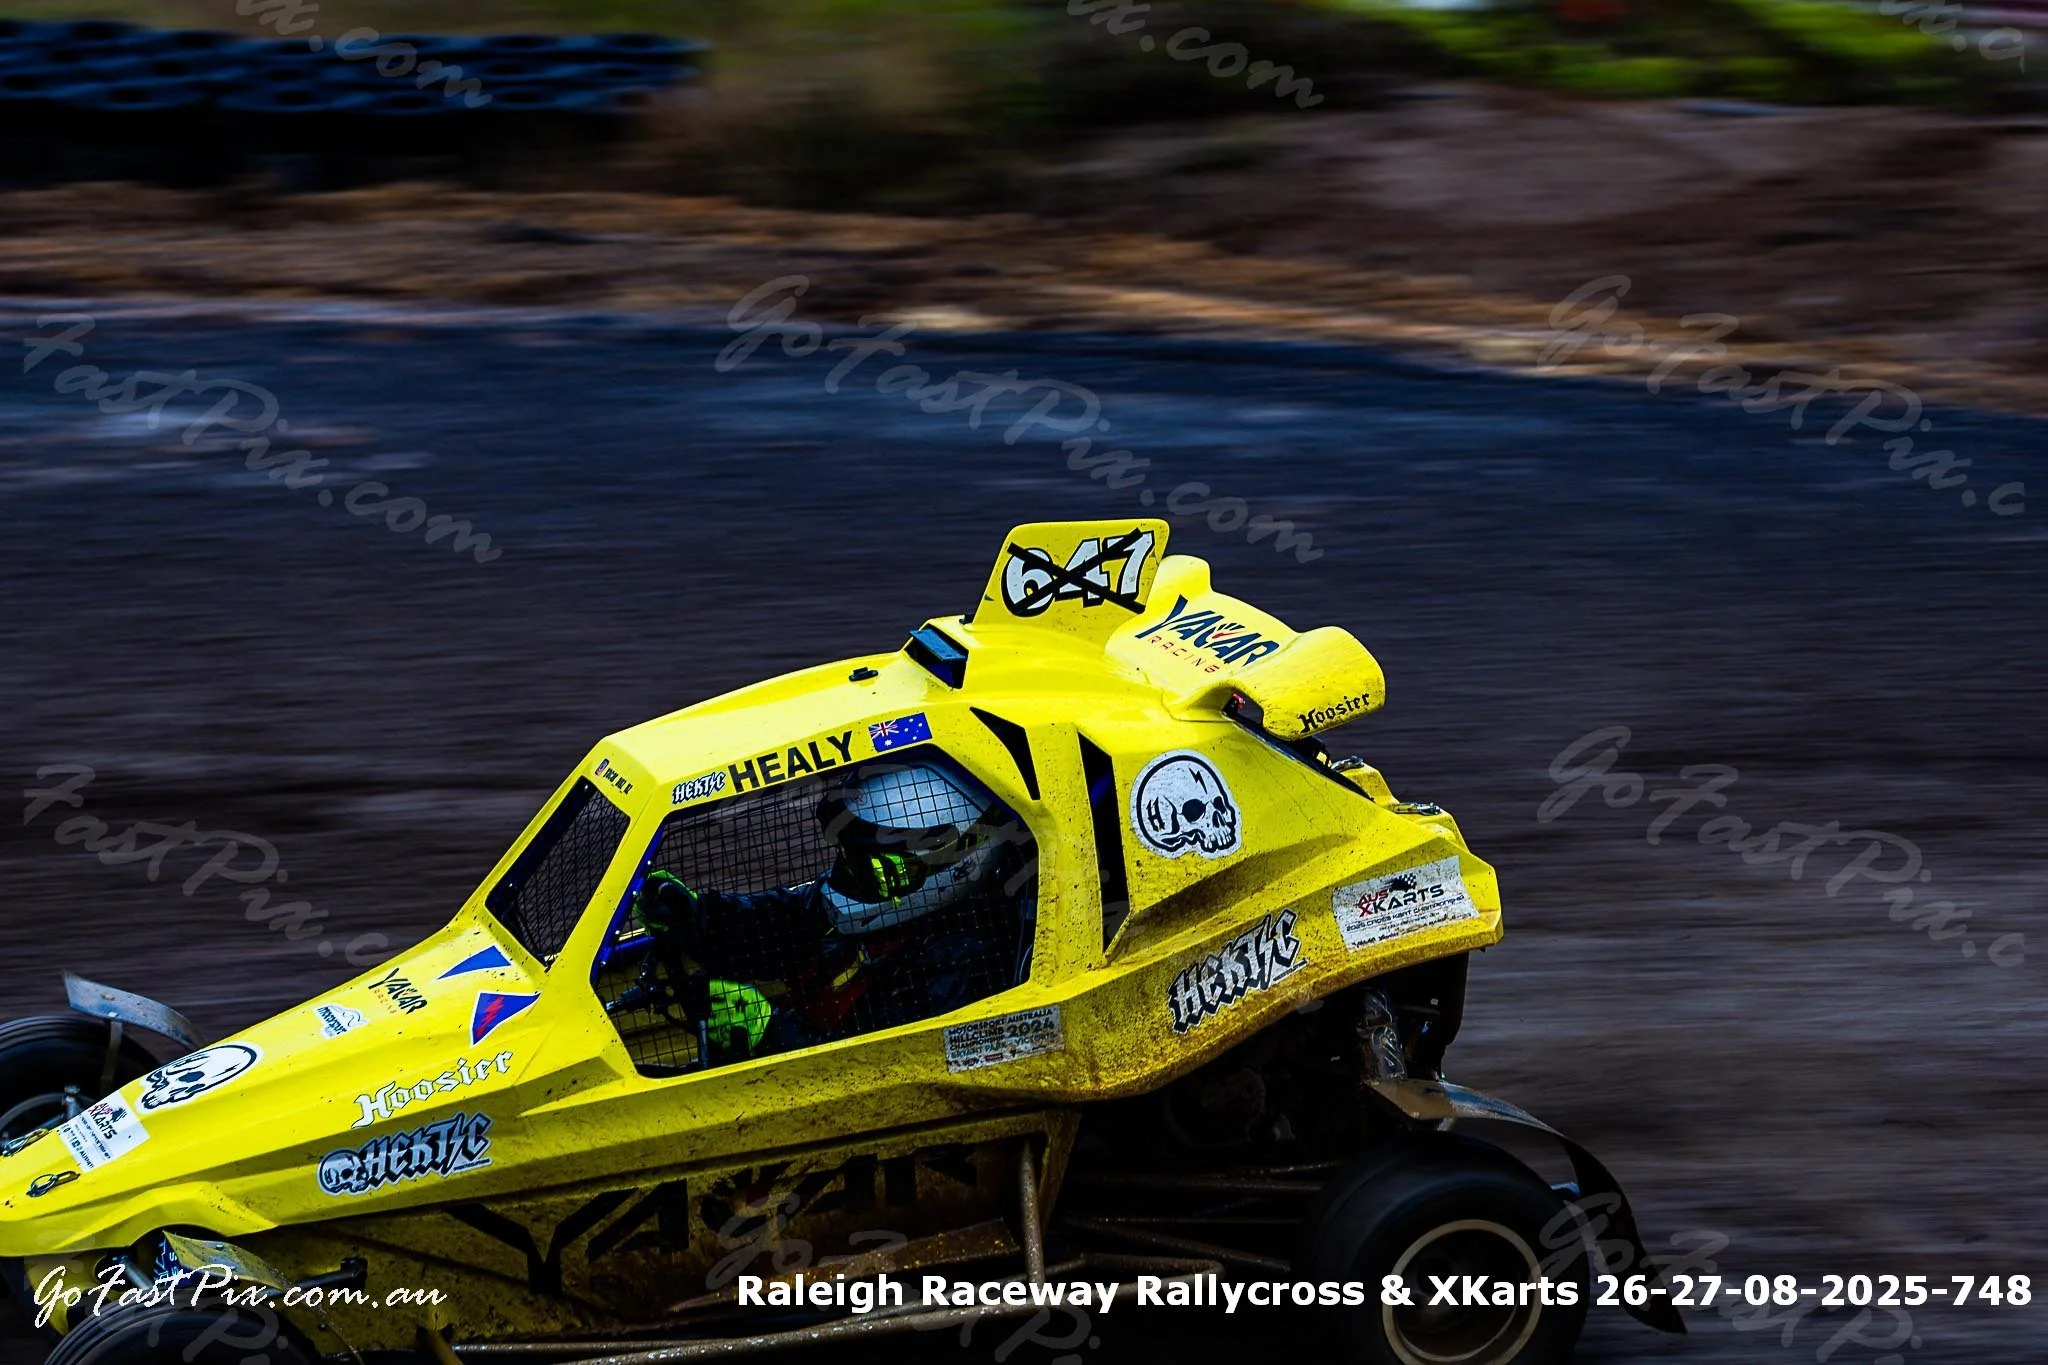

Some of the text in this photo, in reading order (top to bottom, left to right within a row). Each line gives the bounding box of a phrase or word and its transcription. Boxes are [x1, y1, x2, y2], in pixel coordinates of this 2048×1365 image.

[1147, 634, 1222, 675] RACING
[1299, 692, 1371, 733] Hoosier
[728, 730, 854, 794] HEALY
[1357, 884, 1445, 918] XKARTS
[948, 1008, 1054, 1035] MOTORSPORT AUSTRALIA
[948, 1016, 1056, 1045] HILLCLIMB 2024
[351, 1051, 513, 1129] Hoosier
